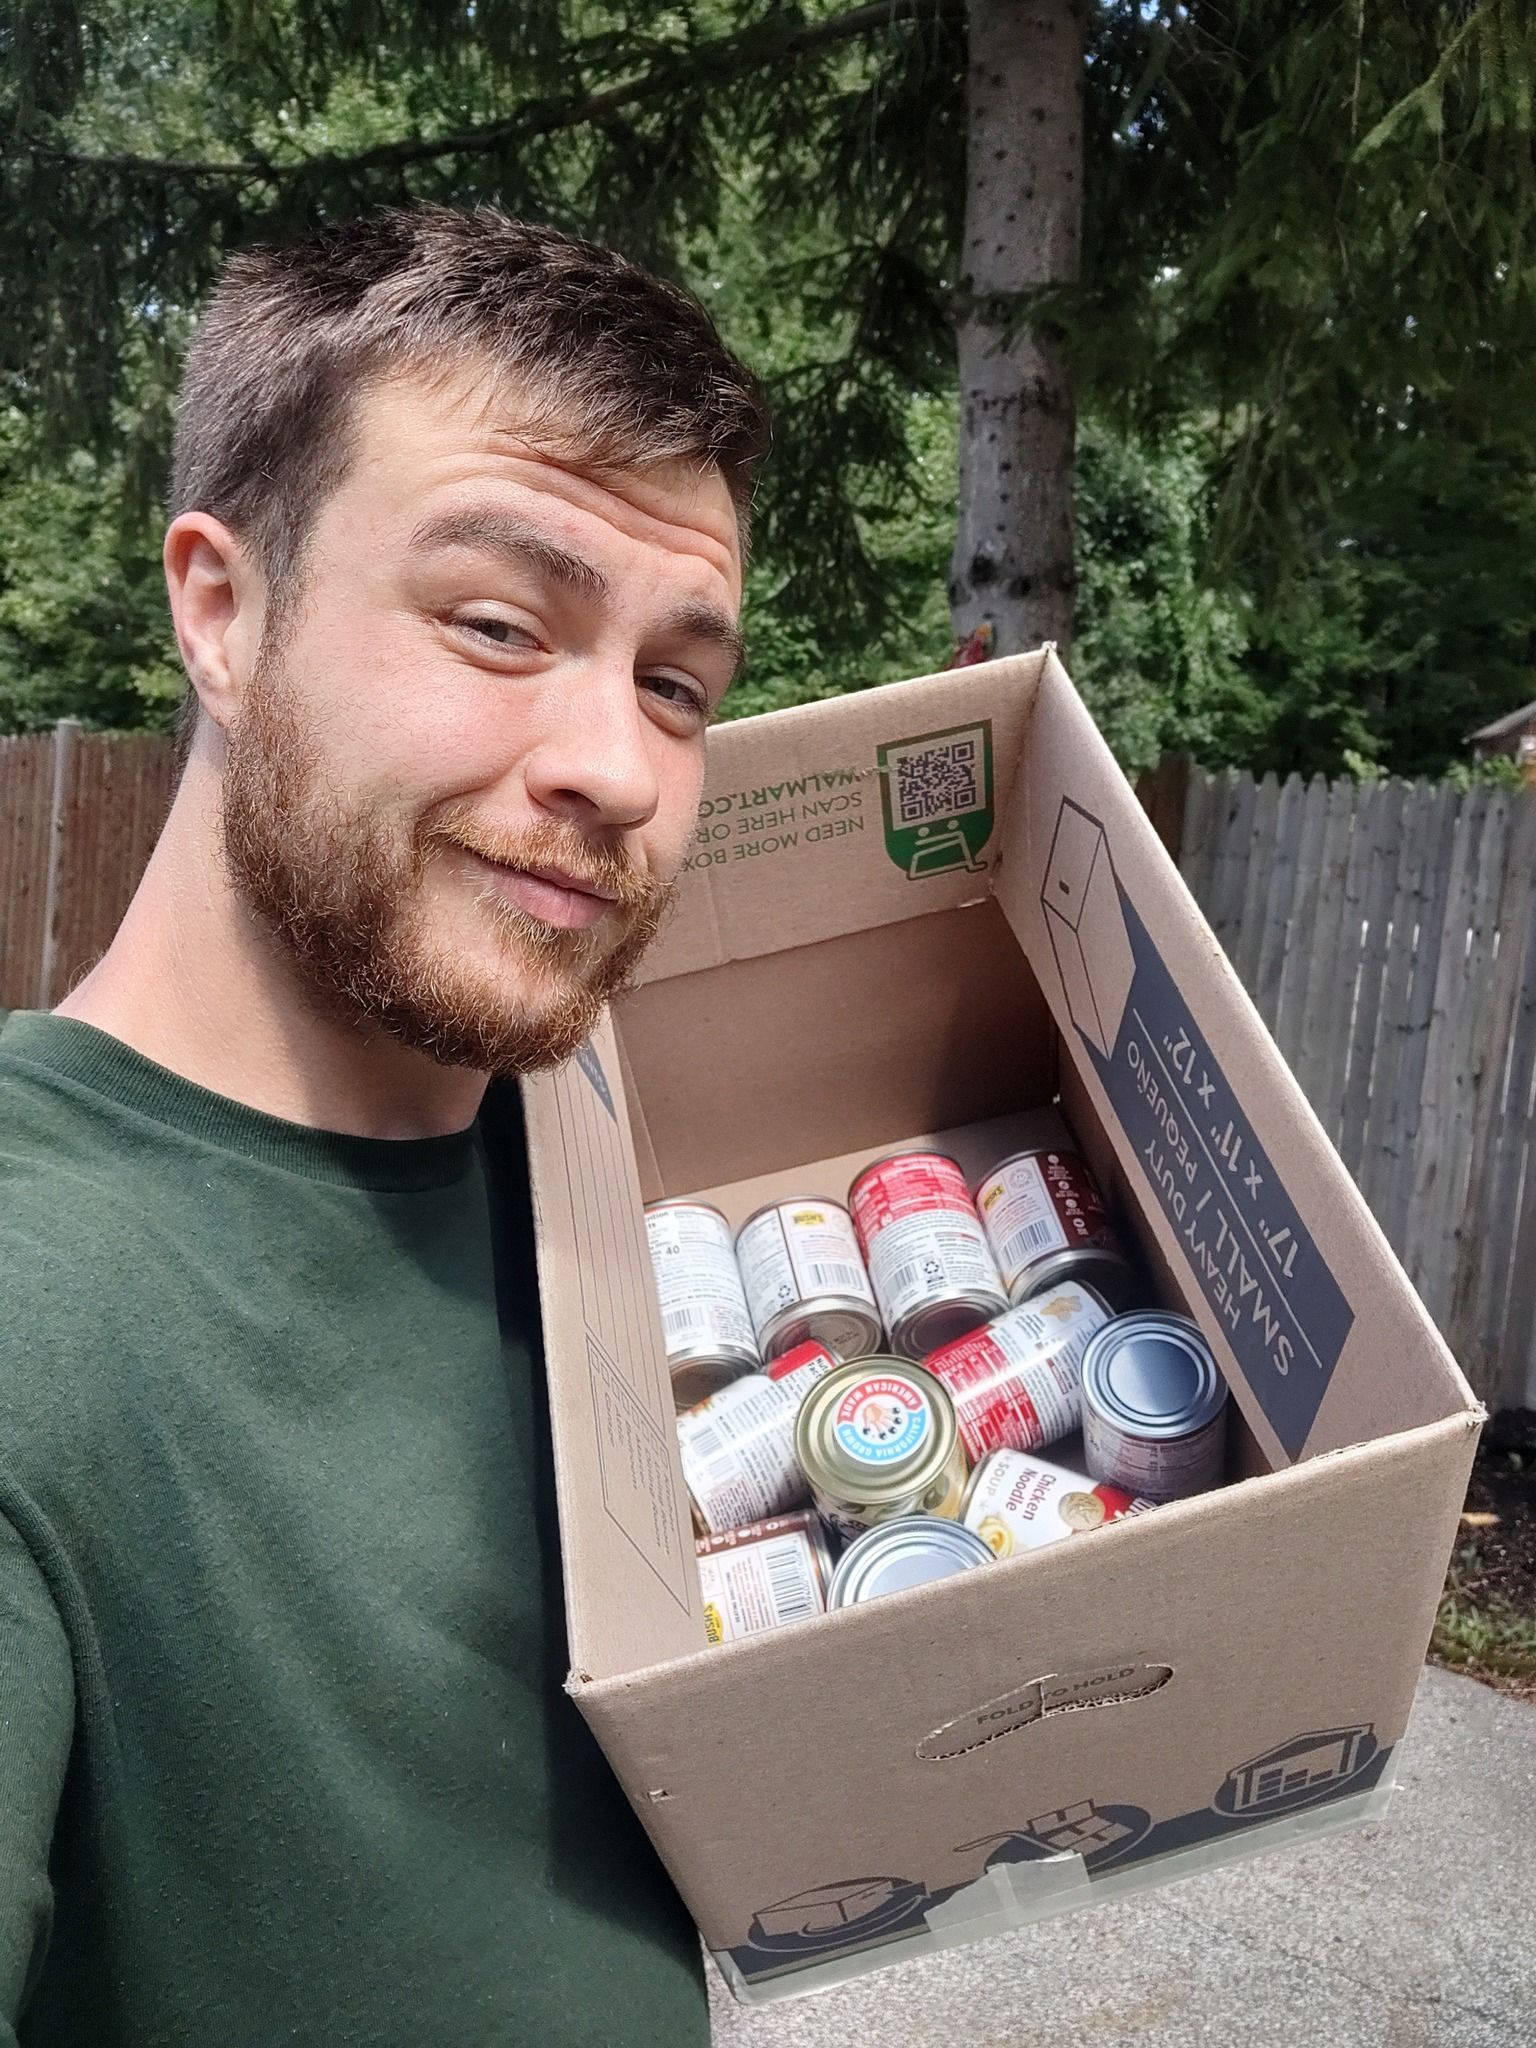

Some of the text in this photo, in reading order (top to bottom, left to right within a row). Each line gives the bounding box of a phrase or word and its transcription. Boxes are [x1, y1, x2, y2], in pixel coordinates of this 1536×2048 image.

[695, 791, 863, 845] SCAN HERE OR
[697, 766, 859, 818] WALMART.CO
[685, 816, 865, 871] NEED MORE BOX
[1163, 1026, 1196, 1084] 12"
[1127, 1041, 1198, 1184] PEQUEÑO
[1210, 1120, 1242, 1172] 11"
[665, 1244, 680, 1255] 40
[1145, 1139, 1240, 1330] HEAVY DUTY
[1258, 1219, 1298, 1278] 17"
[1216, 1208, 1294, 1376] SMALL
[841, 1380, 918, 1418] AMERICAN MADE
[841, 1415, 922, 1458] CALIFORNIA GROWN
[986, 1461, 1010, 1496] SOUP
[1005, 1468, 1039, 1511] Noodle
[1022, 1474, 1057, 1521] Chicken
[703, 1603, 720, 1643] BUSH'S
[976, 1700, 1035, 1725] FOLD
[1072, 1667, 1136, 1692] HOLD
